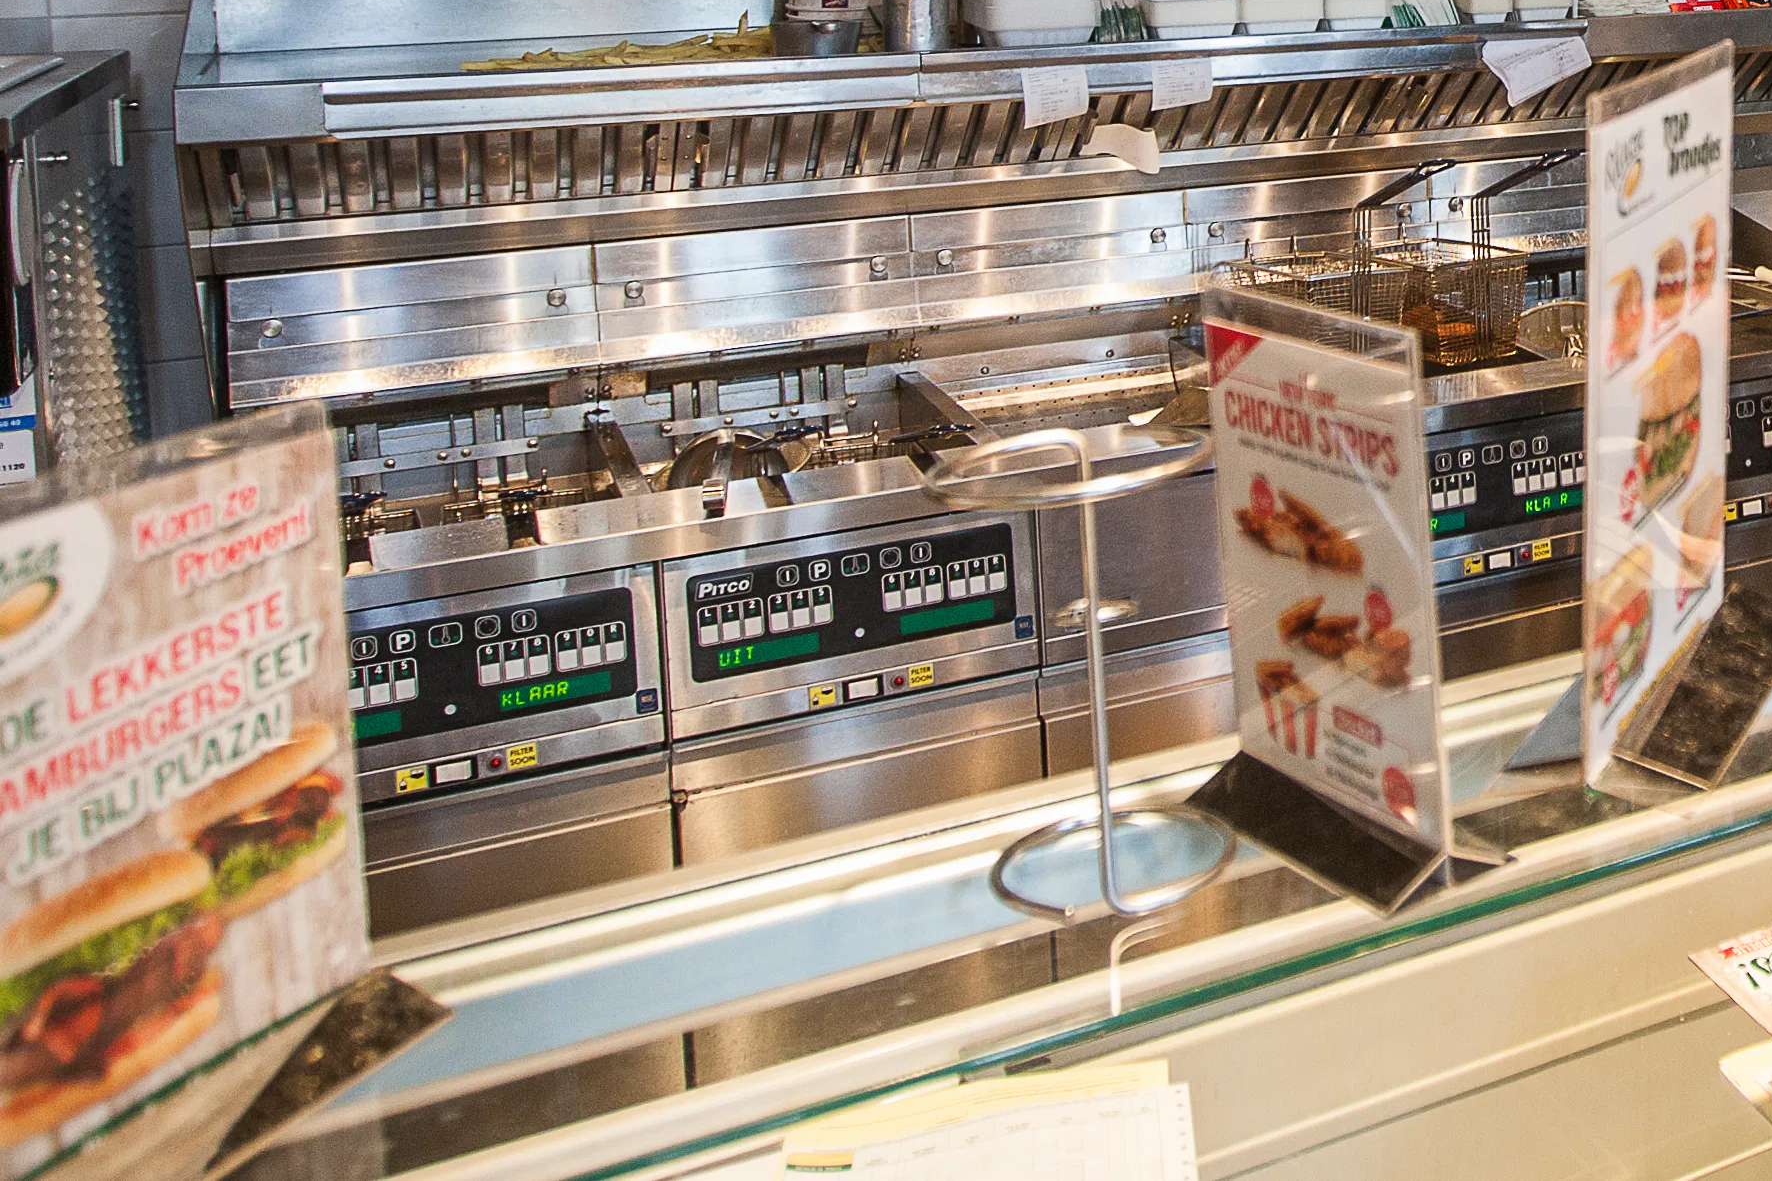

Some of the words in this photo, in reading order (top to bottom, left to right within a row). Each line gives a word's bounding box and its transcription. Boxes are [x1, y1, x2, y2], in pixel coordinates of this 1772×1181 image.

[1223, 389, 1313, 449] CHICKEN
[1316, 415, 1399, 478] STRIPS
[136, 501, 212, 556] Kom
[174, 503, 310, 588] Proeven!
[697, 576, 751, 599] PITCO
[65, 589, 285, 726] LEKKERSTE
[252, 632, 312, 691] EET
[718, 645, 755, 668] UIT
[501, 680, 570, 707] KLAAR
[909, 673, 934, 685] SOON
[154, 702, 283, 802] PLAZA!
[509, 745, 535, 758] FILTER
[509, 754, 536, 768] SOON
